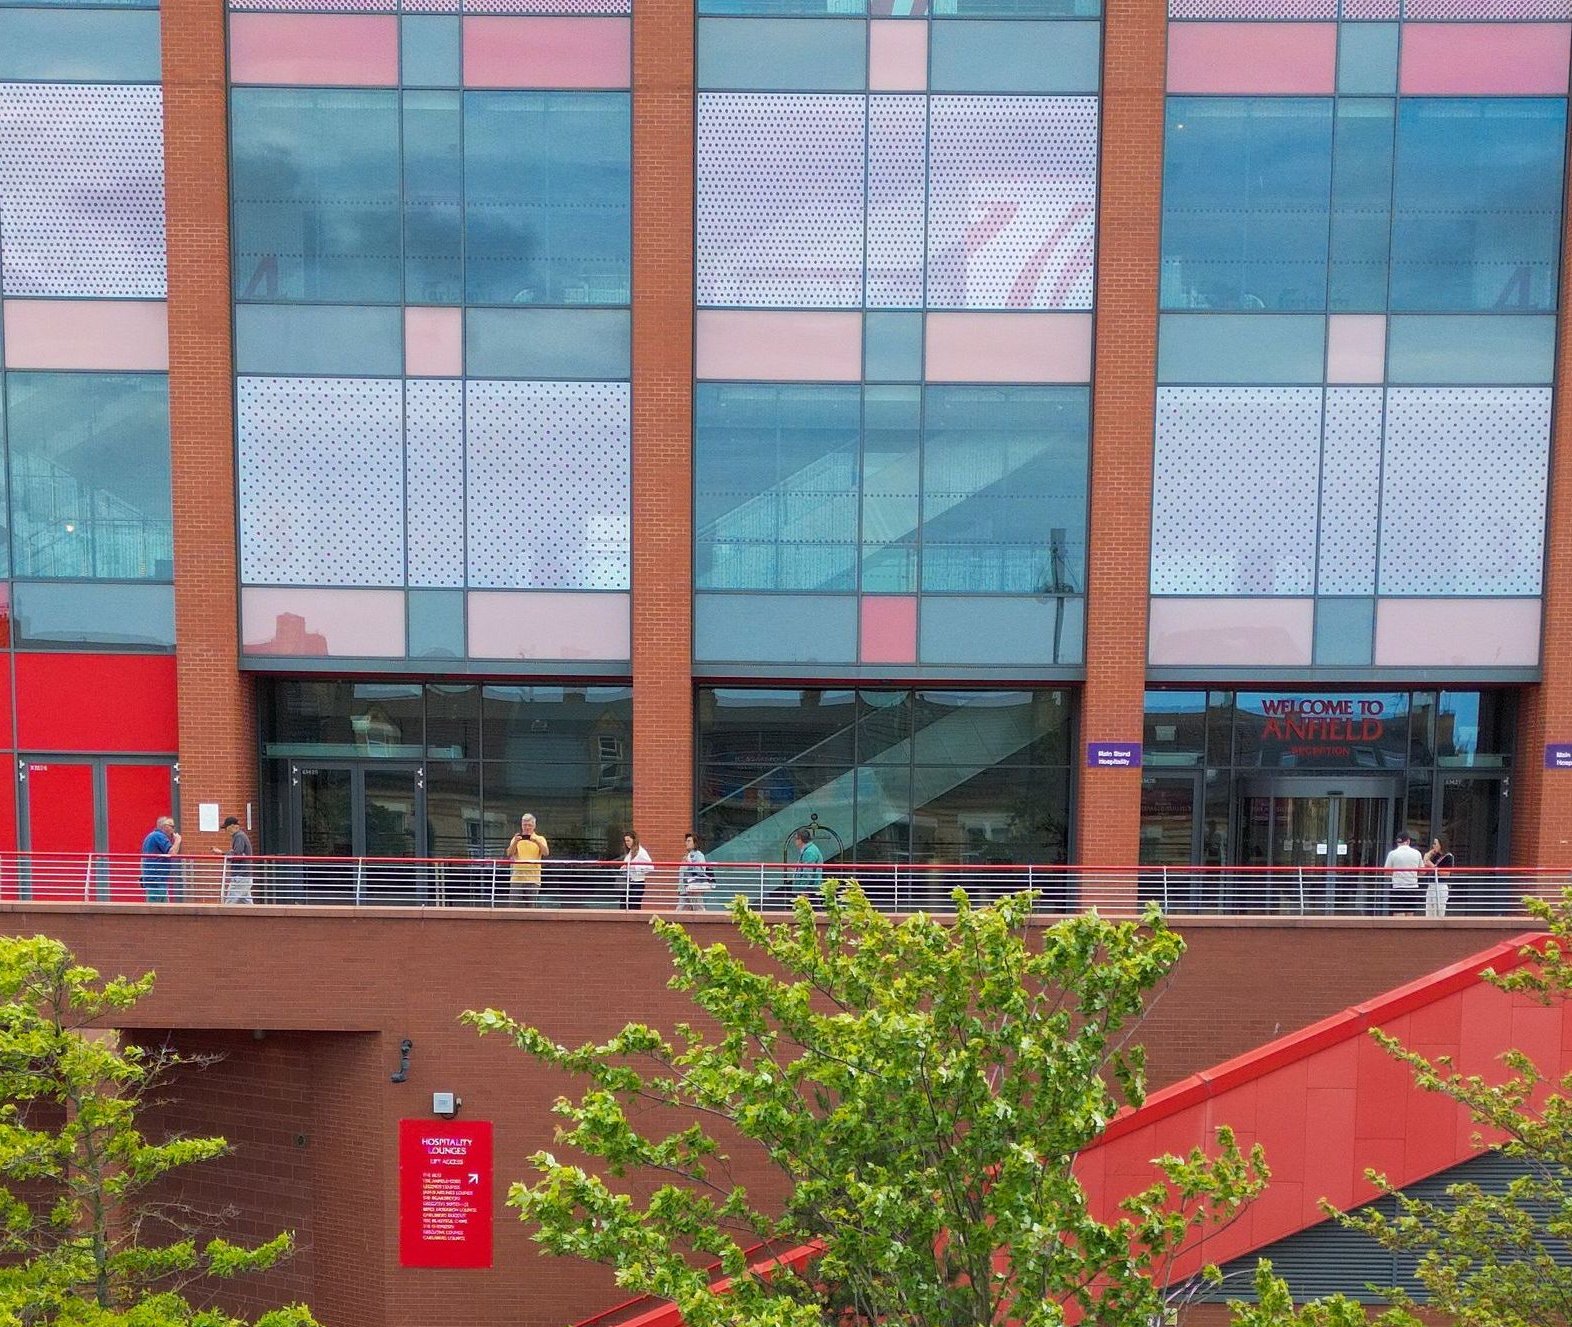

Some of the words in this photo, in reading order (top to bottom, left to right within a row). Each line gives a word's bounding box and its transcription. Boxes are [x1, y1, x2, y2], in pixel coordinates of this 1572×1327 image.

[1262, 699, 1347, 715] WELCOME
[1357, 699, 1383, 715] TO
[1262, 716, 1384, 743] ANFIELD
[422, 1138, 473, 1147] HOSPITALITY
[427, 1147, 467, 1155] LOUNGES
